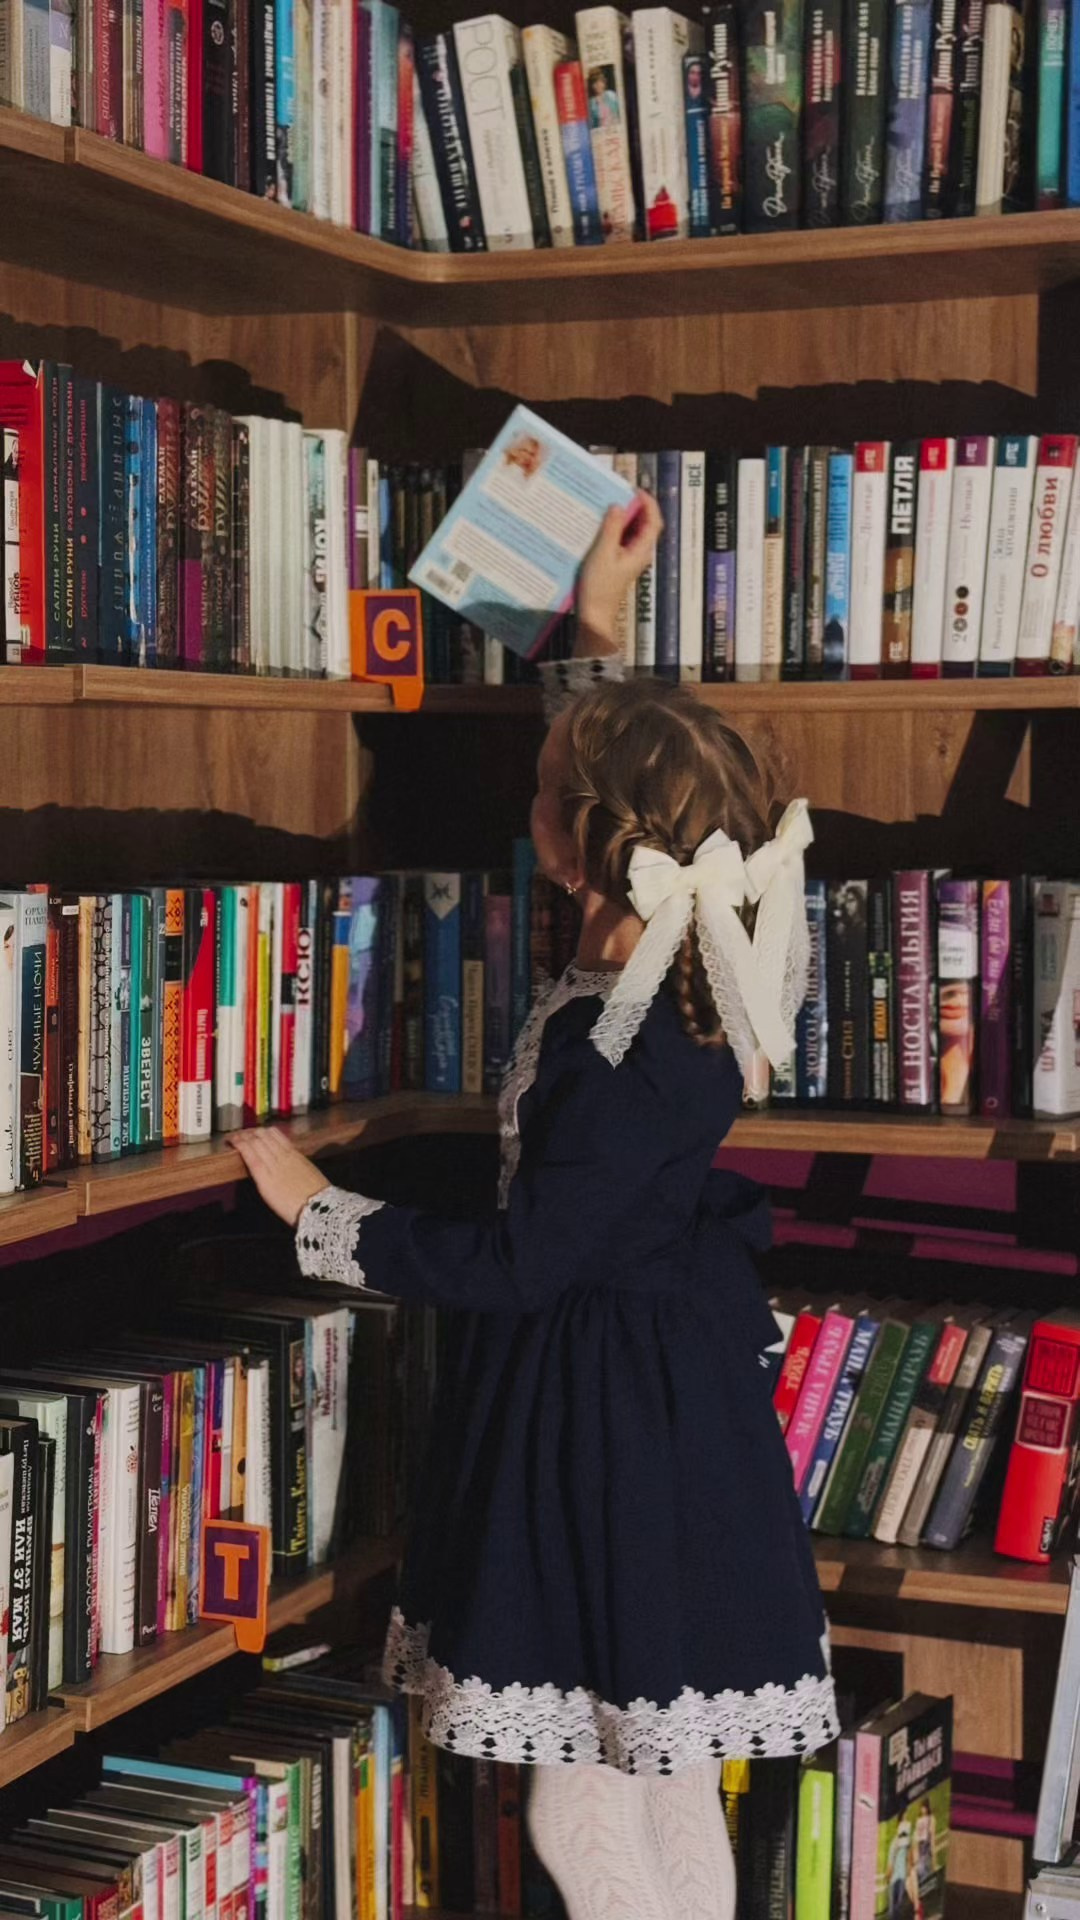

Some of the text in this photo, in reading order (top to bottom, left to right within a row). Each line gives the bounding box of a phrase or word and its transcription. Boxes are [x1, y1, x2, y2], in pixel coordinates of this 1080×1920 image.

[65, 459, 74, 531] РАЗГОВОРЫ
[890, 455, 914, 535] ПЕТЛЯ
[51, 523, 60, 563] РУНИ
[65, 537, 74, 574] РУНИ
[1030, 476, 1058, 578] О любви
[52, 568, 60, 622] САЛЛИ
[65, 575, 74, 630] САЛЛИ
[372, 608, 411, 661] С
[32, 951, 42, 997] НОЧИ
[804, 1005, 820, 1078] УГОЛОК
[140, 1036, 152, 1109] ЭВЕРЕСТ
[796, 1324, 844, 1438] МАША ТРАУБ
[823, 1386, 856, 1442] ТРАУБ
[148, 1488, 161, 1534] Пепел
[25, 1514, 34, 1589] БРАЧНАЯ
[214, 1542, 250, 1600] Т
[11, 1519, 26, 1643] ИЛИ 37 МАЯ
